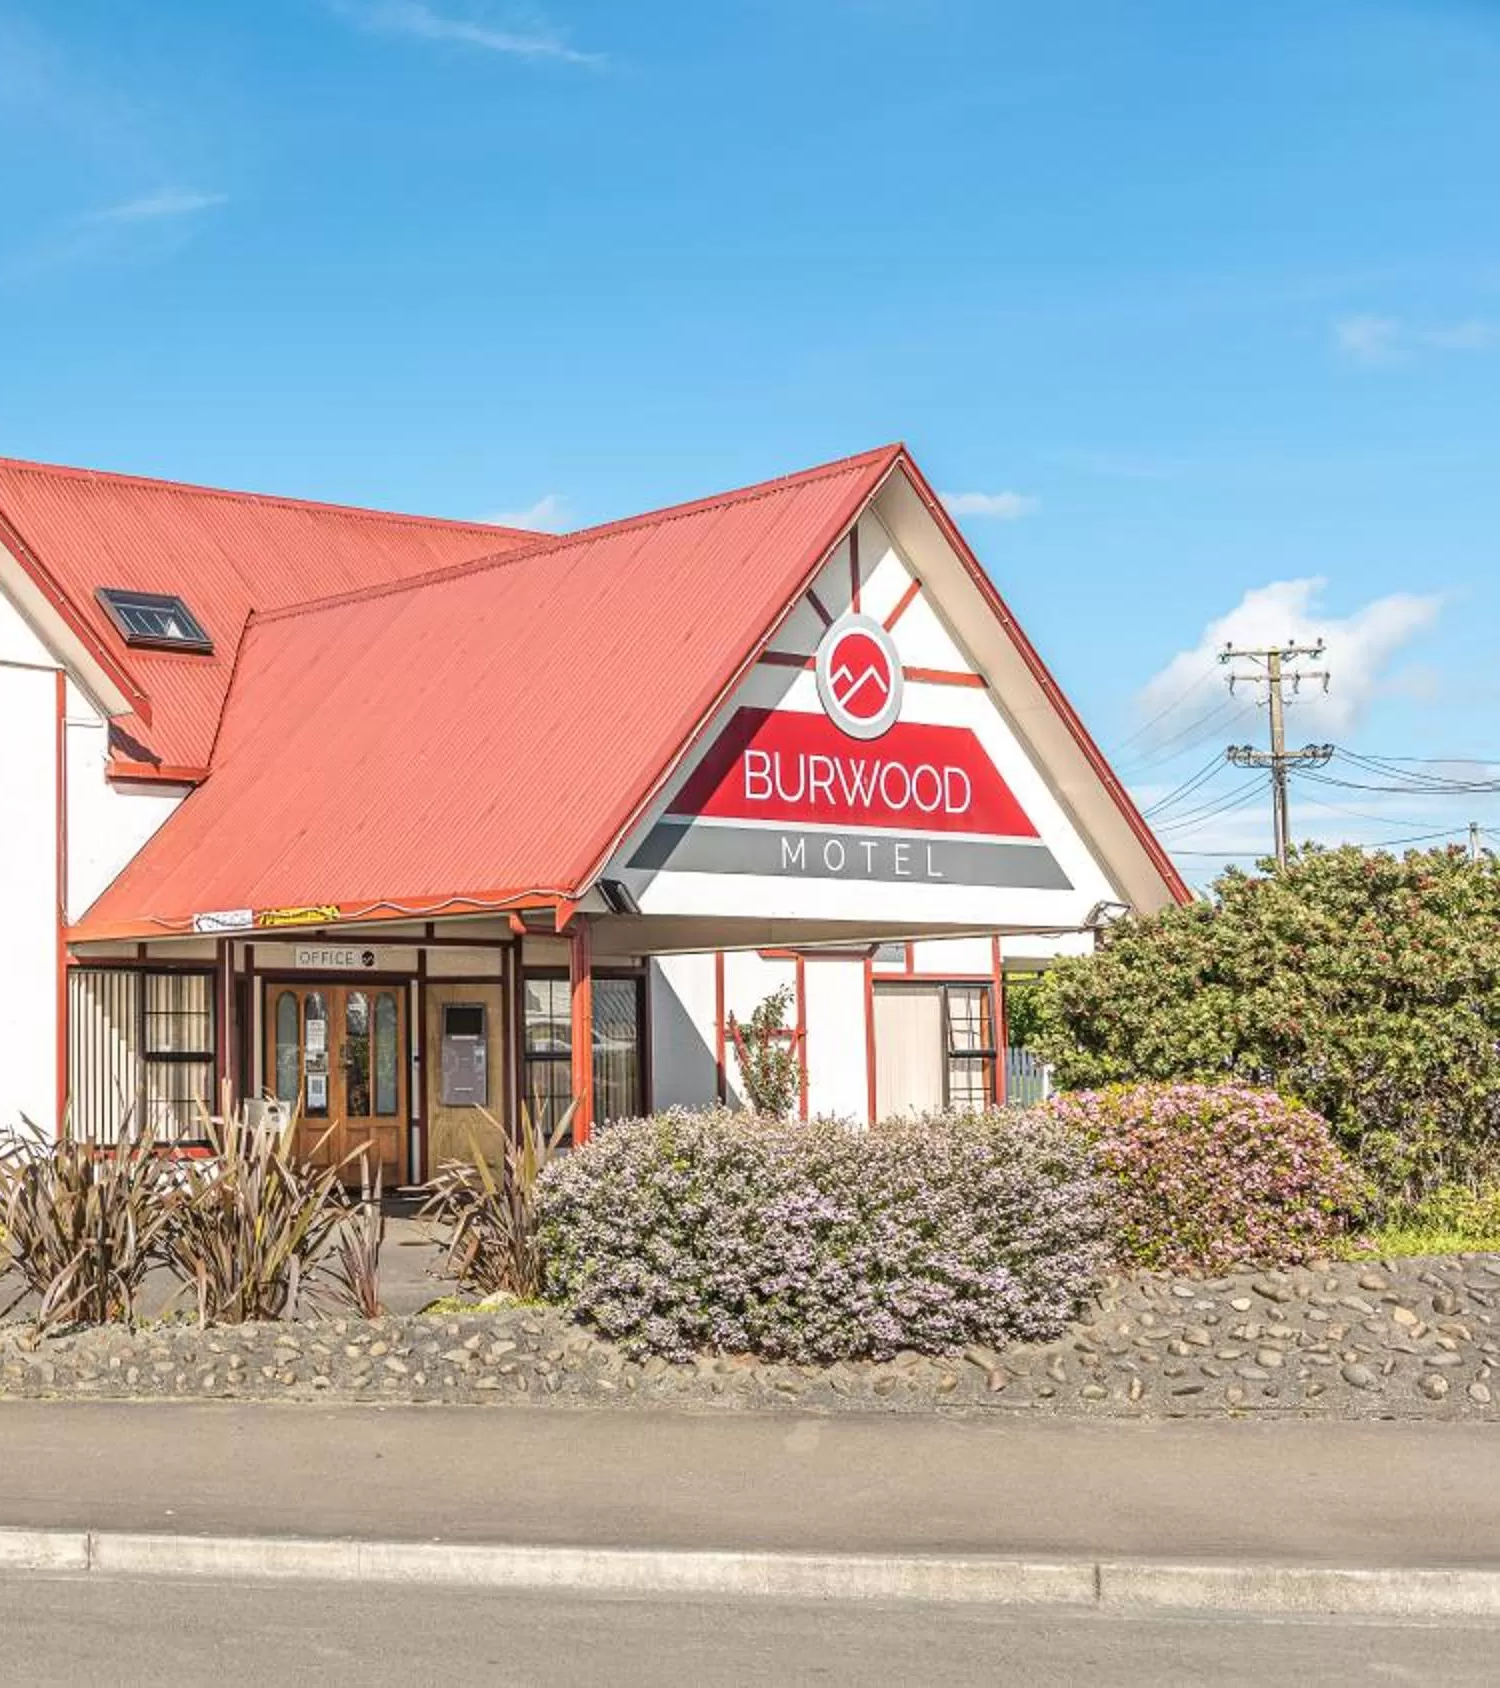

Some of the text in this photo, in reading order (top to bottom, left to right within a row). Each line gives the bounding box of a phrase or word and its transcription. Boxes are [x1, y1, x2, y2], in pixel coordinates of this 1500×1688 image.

[744, 749, 972, 814] BURWOOD
[781, 836, 944, 878] MOTEL
[300, 951, 354, 966] OFFICE
